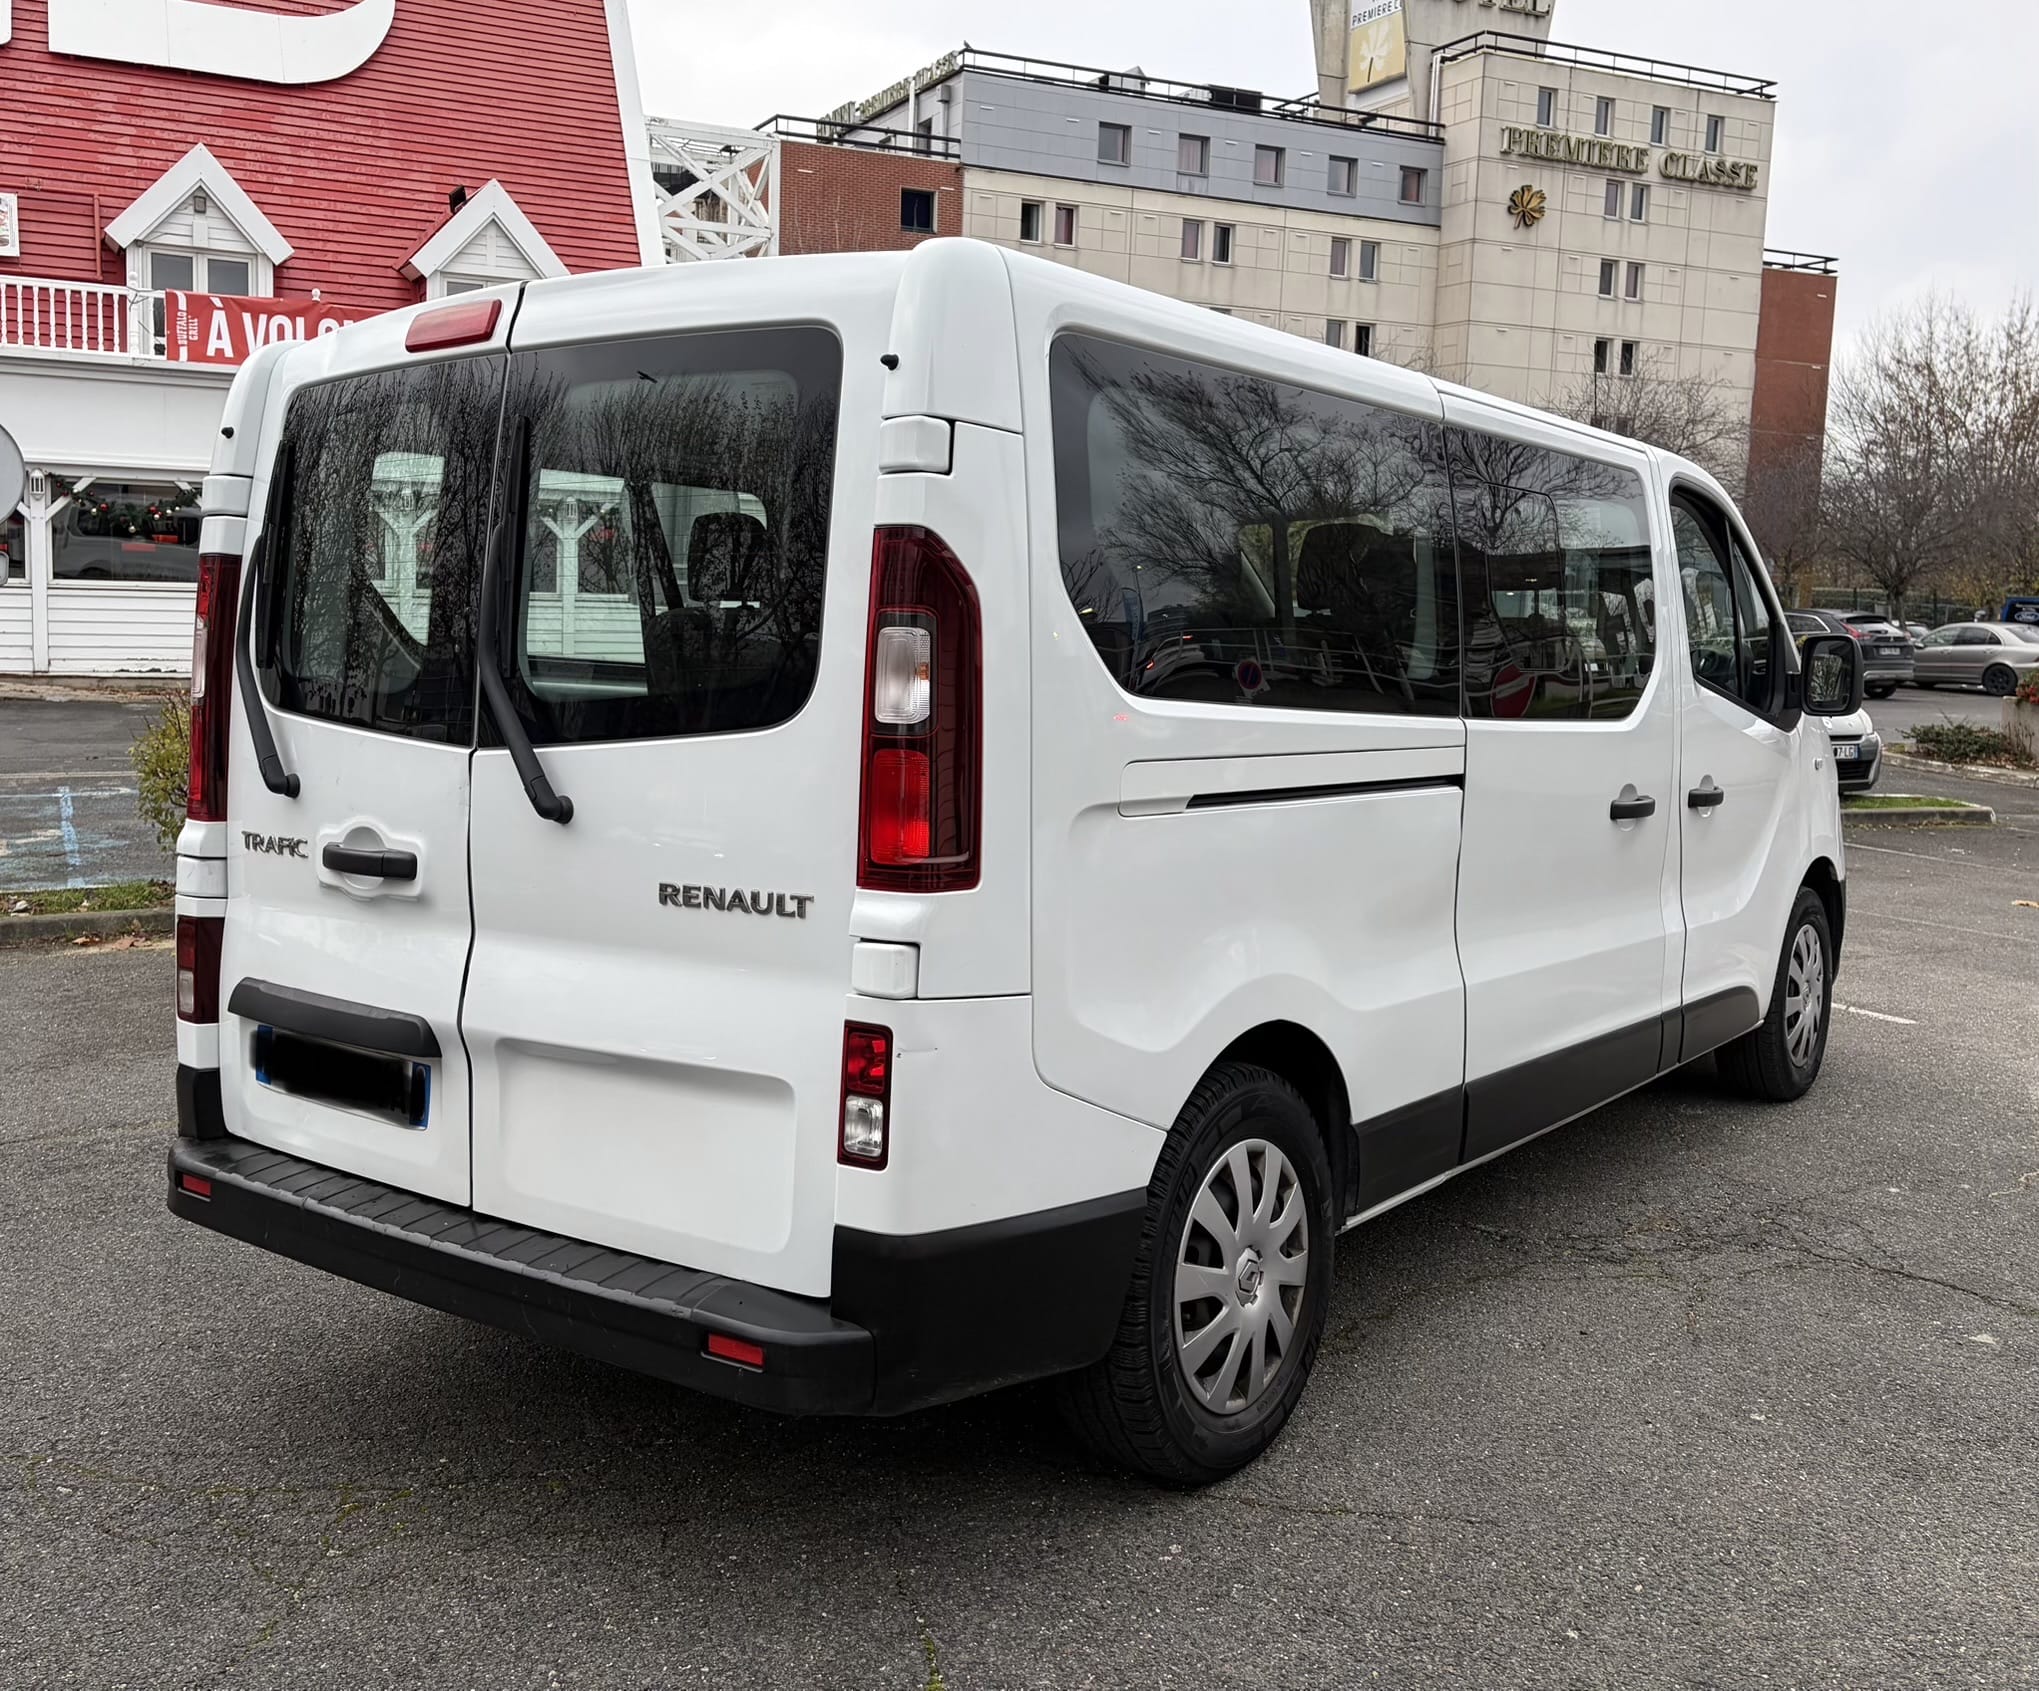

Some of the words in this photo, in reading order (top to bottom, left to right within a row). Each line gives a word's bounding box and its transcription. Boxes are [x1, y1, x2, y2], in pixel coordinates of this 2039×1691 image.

[1352, 1, 1392, 26] PREMIERE
[1500, 126, 1649, 174] PREMIERE
[1658, 151, 1759, 190] CLASSE
[176, 311, 187, 345] BUFFALO
[206, 297, 233, 358] À
[241, 831, 308, 859] TRAFIC
[658, 882, 814, 919] RENAULT
